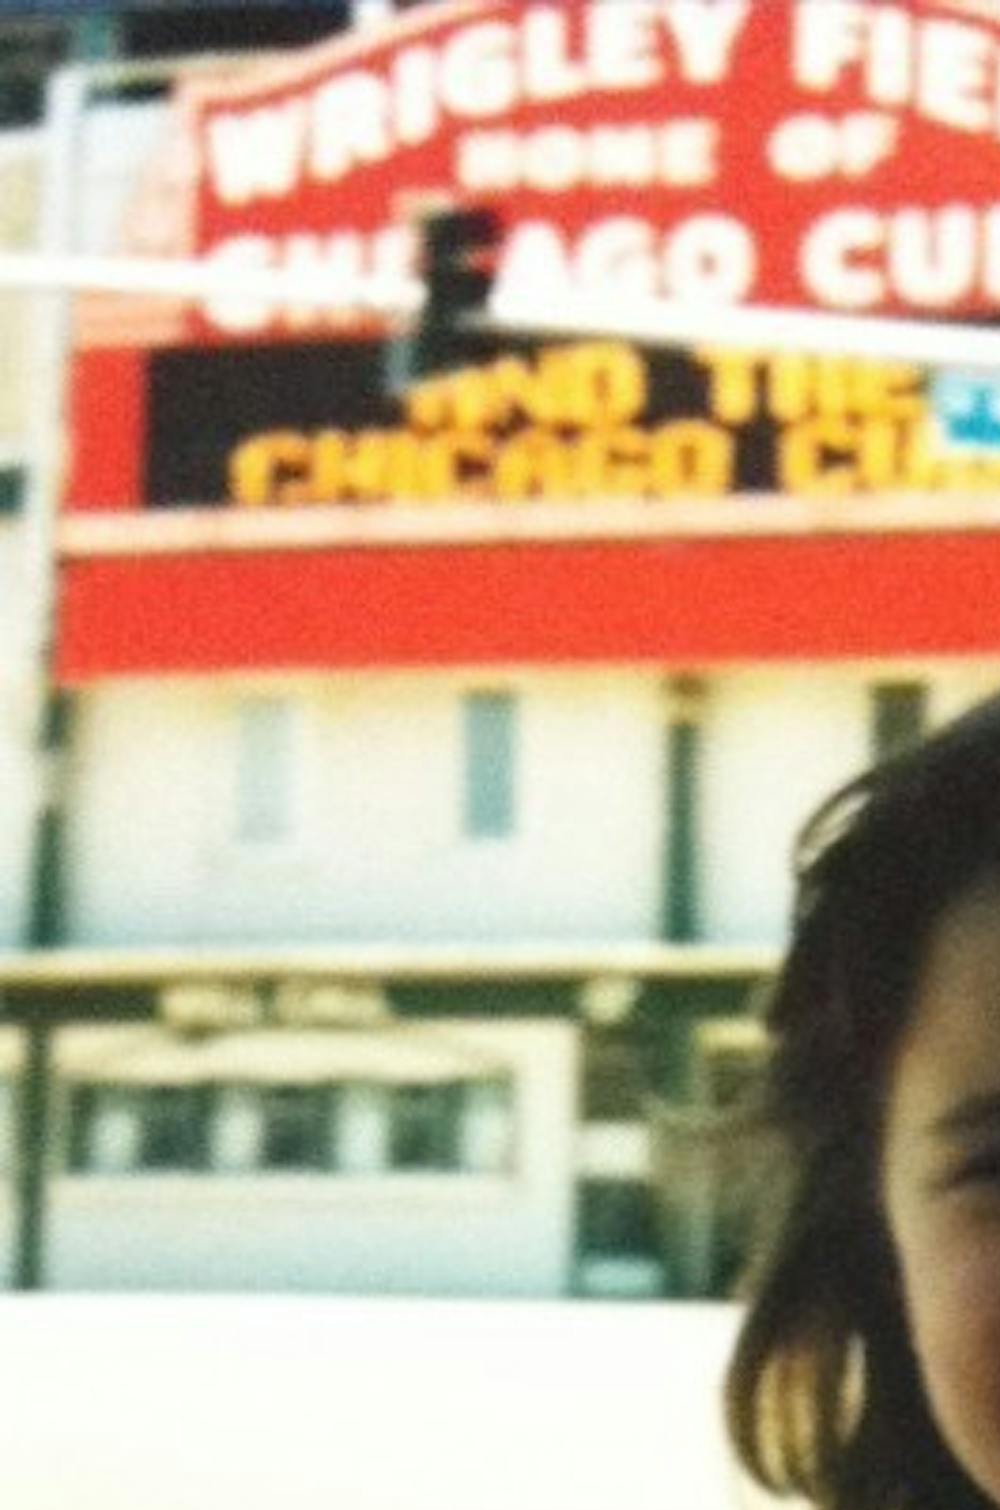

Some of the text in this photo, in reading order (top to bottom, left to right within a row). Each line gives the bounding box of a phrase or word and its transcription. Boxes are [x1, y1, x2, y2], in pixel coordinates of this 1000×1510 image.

[207, 0, 754, 206] WRIGLEY
[455, 110, 899, 192] HOME OF
[203, 214, 757, 333] CHIAGO
[229, 420, 736, 503] CHICAGO
